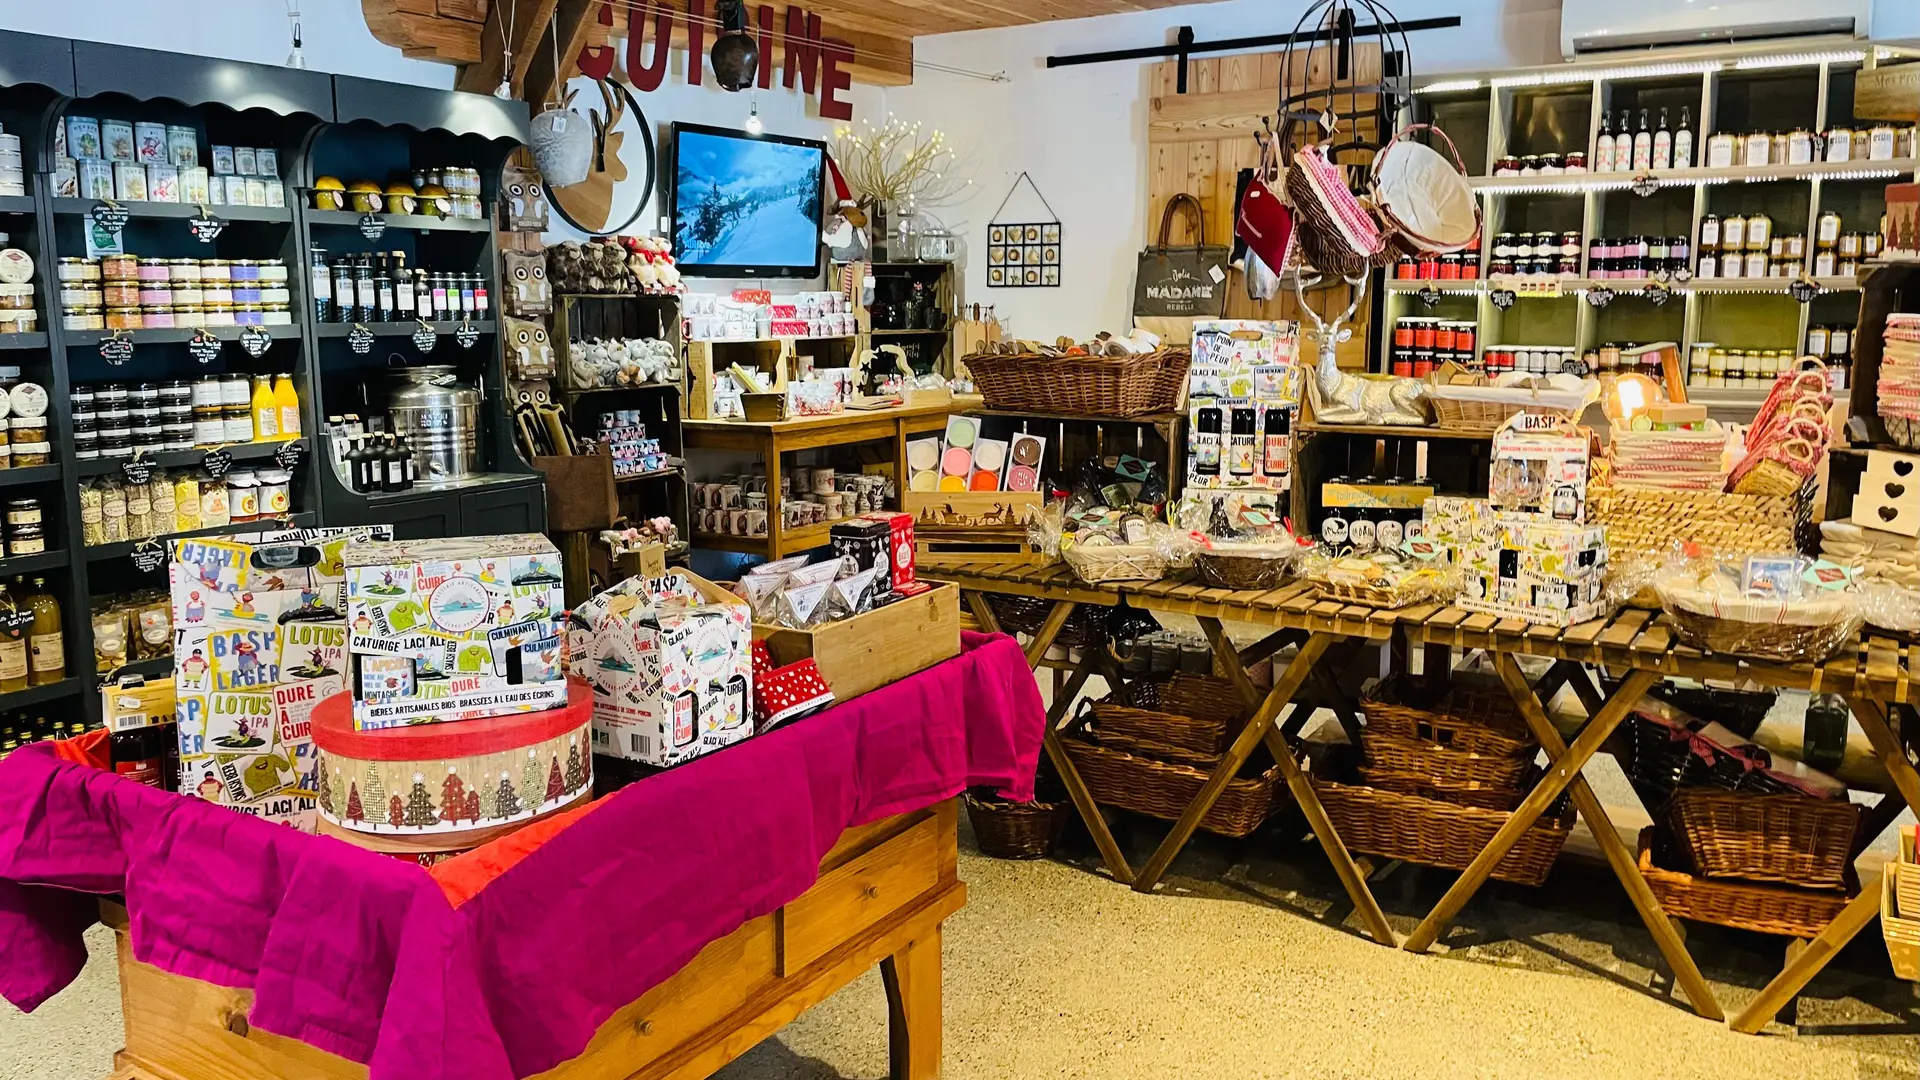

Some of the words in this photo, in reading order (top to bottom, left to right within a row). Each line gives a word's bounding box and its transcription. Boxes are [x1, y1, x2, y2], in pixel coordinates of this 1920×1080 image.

[577, 0, 855, 121] CUIINE
[1146, 285, 1213, 299] MADAME
[1166, 303, 1194, 311] REBELLE
[1209, 352, 1230, 366] PEUR
[1524, 416, 1556, 429] BASP
[1266, 436, 1288, 447] DURE
[1265, 460, 1286, 469] CUIRE
[182, 543, 247, 570] LAGER
[394, 569, 409, 580] IPA
[417, 575, 447, 591] CUIRE
[289, 625, 345, 646] LOTUS
[490, 622, 537, 641] CULMINANTE
[667, 627, 693, 647] GLACI'AL
[353, 635, 401, 653] CATURIGE
[323, 647, 342, 660] IPA
[217, 664, 280, 691] LAGER
[451, 677, 481, 693] DURE
[276, 684, 315, 705] DURE
[364, 689, 398, 700] MONTAGNE
[395, 702, 440, 715] ARTISANALES
[441, 700, 456, 710] BIOS
[519, 691, 532, 701] DES
[215, 695, 272, 716] LOTUS
[250, 716, 269, 729] IPA
[282, 721, 312, 741] CUIR
[222, 762, 238, 781] BEER
